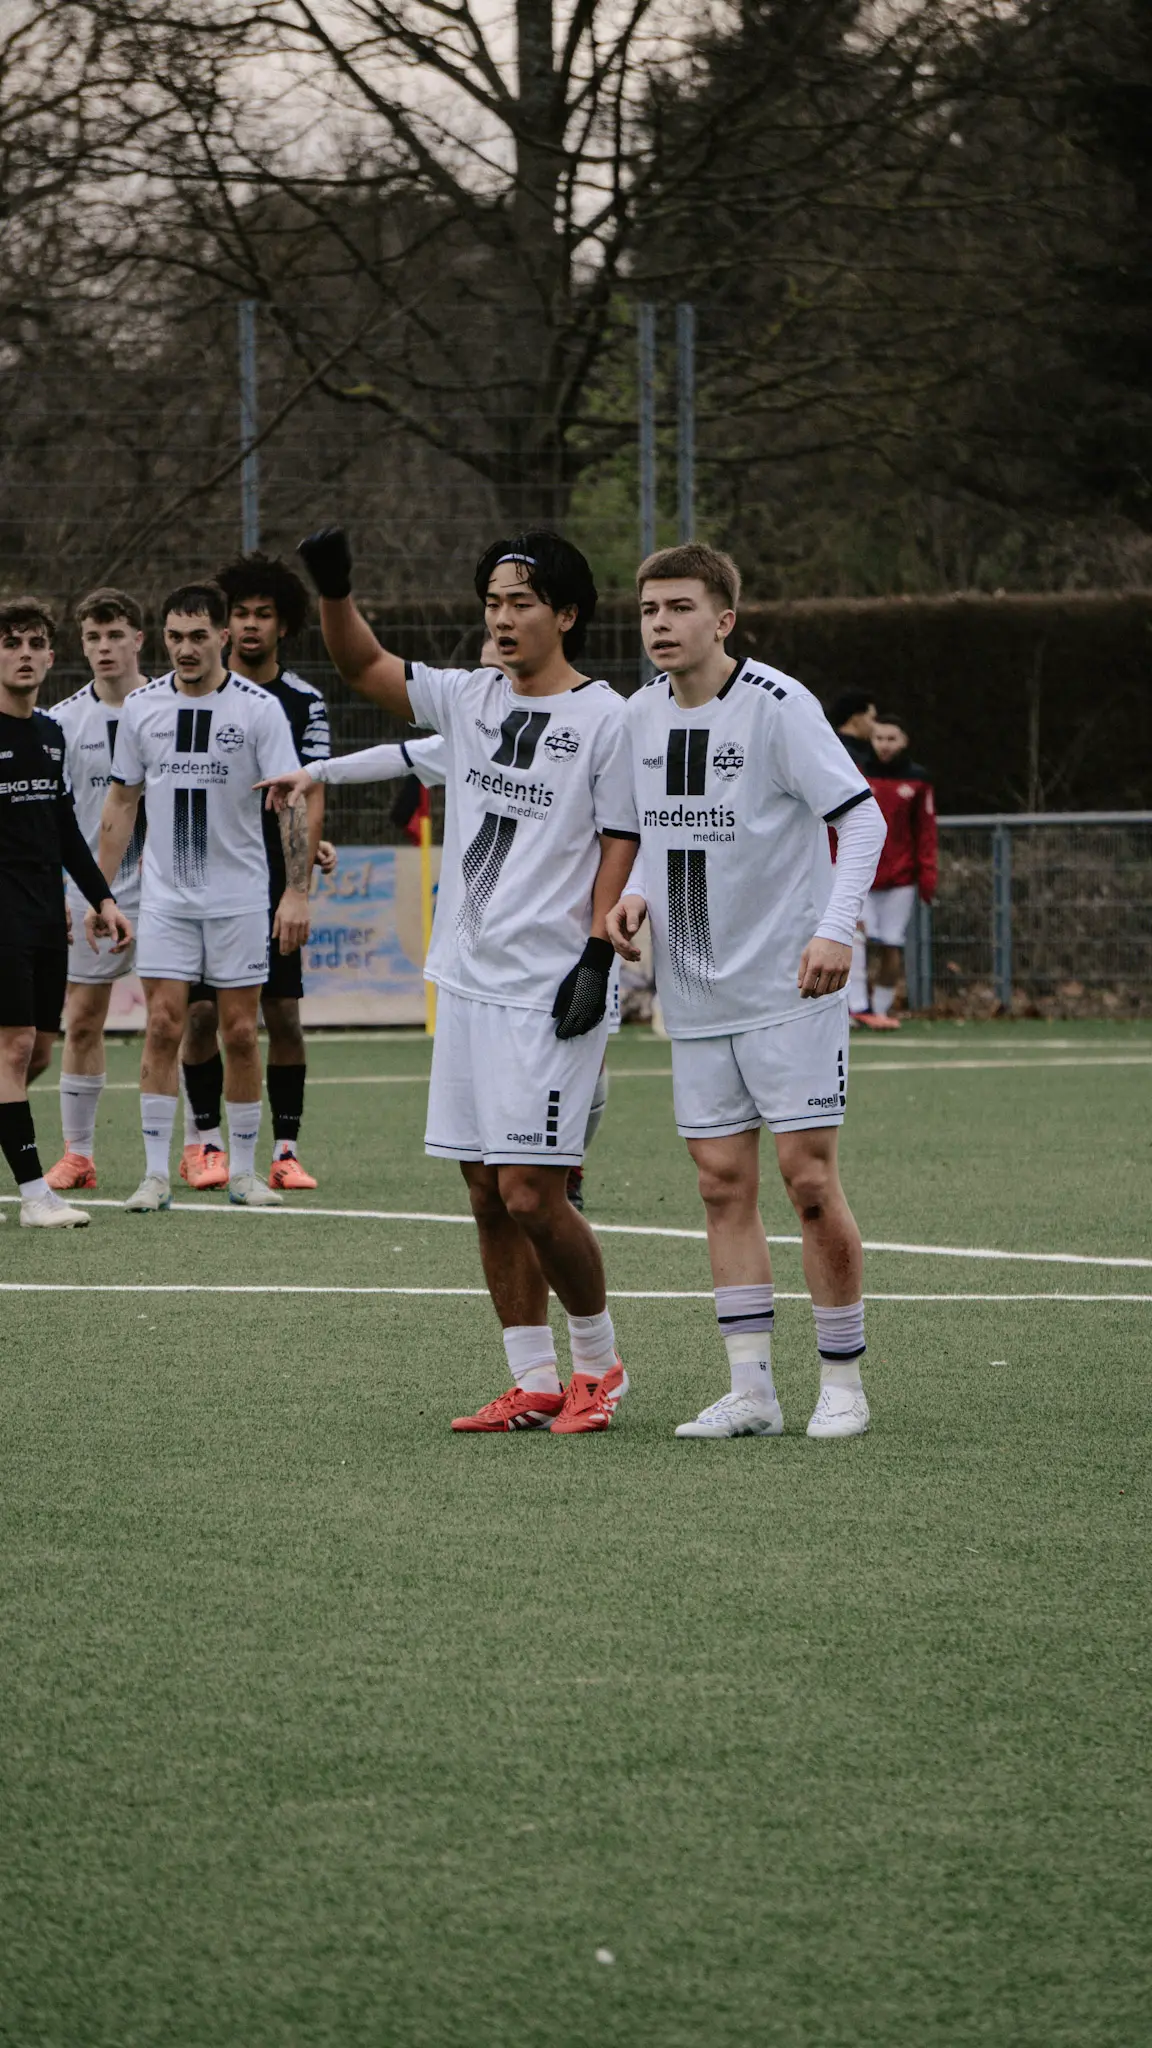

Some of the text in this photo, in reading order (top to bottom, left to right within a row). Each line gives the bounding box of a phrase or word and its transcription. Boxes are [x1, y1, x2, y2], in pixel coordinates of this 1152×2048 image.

[80, 742, 105, 751] capelli
[546, 737, 579, 752] ABC
[714, 757, 744, 767] ABC
[466, 768, 554, 807] medentis
[507, 804, 548, 821] medical
[644, 804, 735, 827] medentis
[693, 832, 735, 842] medical
[507, 1133, 543, 1143] capelli
